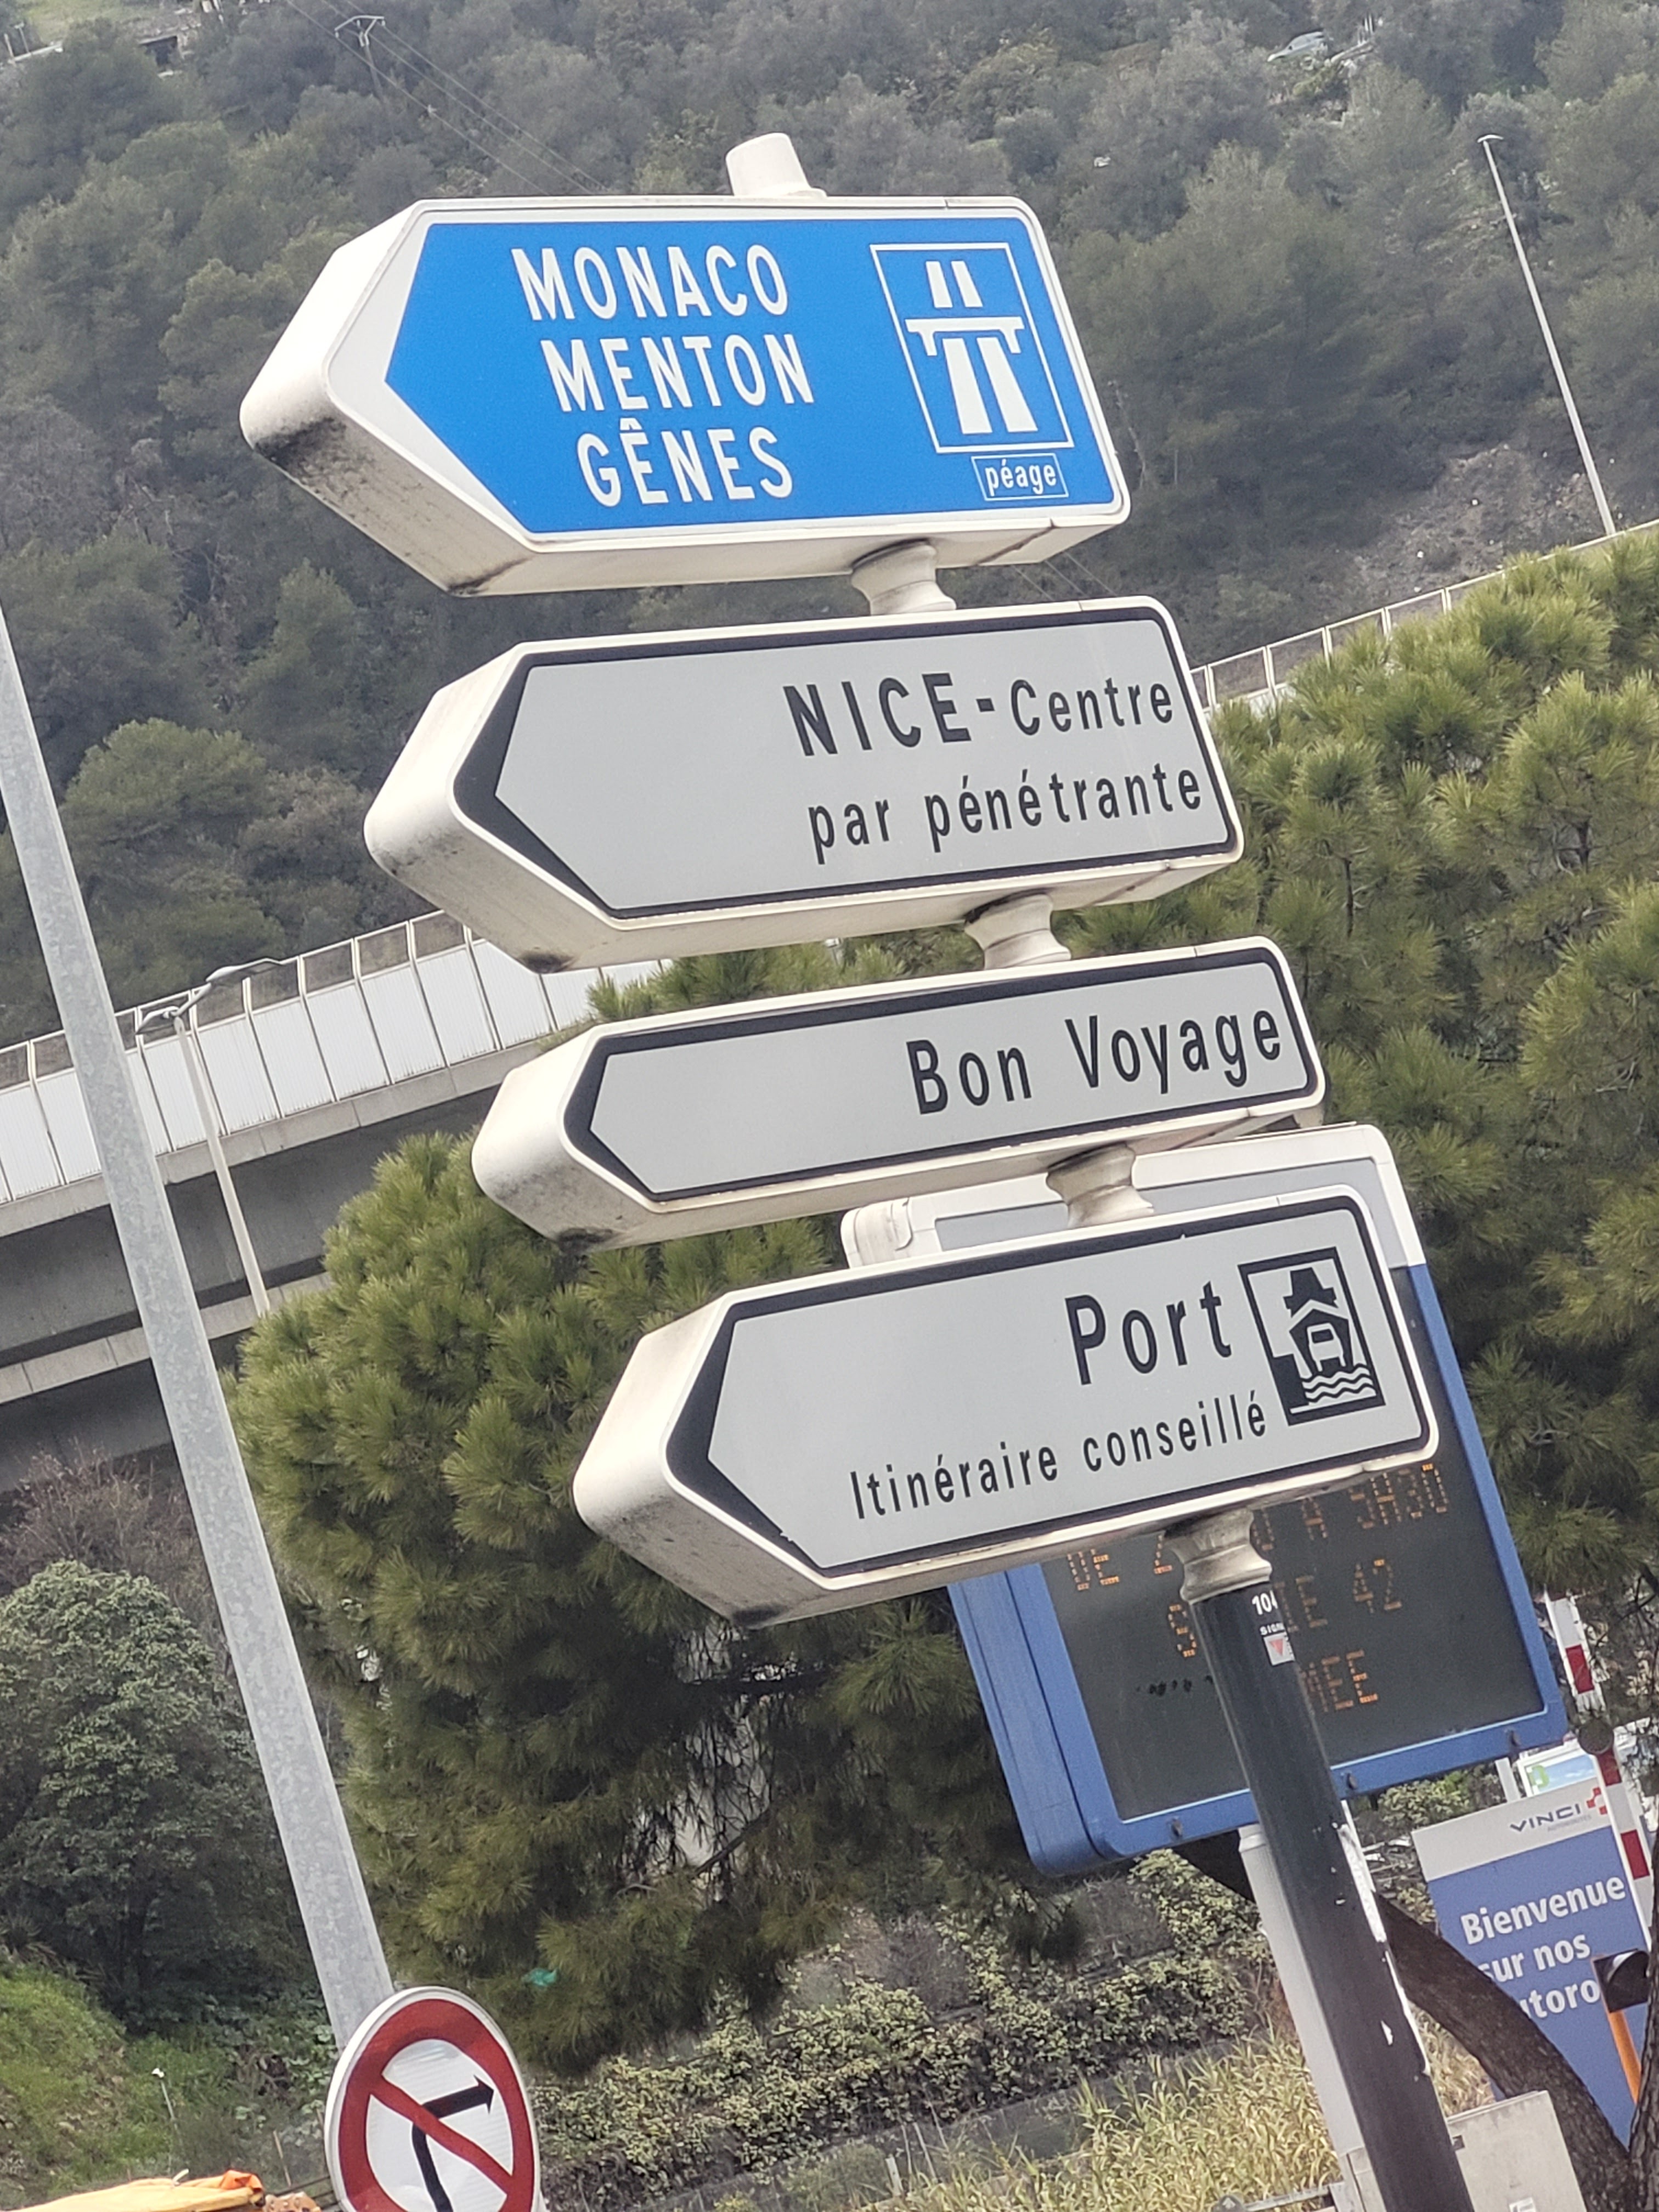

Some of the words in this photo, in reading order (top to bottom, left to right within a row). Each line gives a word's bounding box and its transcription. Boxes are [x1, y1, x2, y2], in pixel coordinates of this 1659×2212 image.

[511, 245, 789, 321] MONACO
[540, 334, 814, 412] MENTON
[577, 418, 793, 507] GÊNES
[985, 459, 1057, 496] péage
[808, 797, 890, 865] par
[924, 763, 1201, 853] pénétrante
[906, 1039, 1032, 1115] Bon
[1065, 1009, 1282, 1095] Voyage
[1065, 1281, 1233, 1386] Port
[850, 1441, 1058, 1520] Itinéraire
[1082, 1390, 1266, 1473] conseillé
[1353, 1559, 1403, 1613] 42
[1510, 1803, 1581, 1832] VINCI
[1460, 1877, 1626, 1945] Bienvenue
[1533, 1934, 1590, 1971] nos
